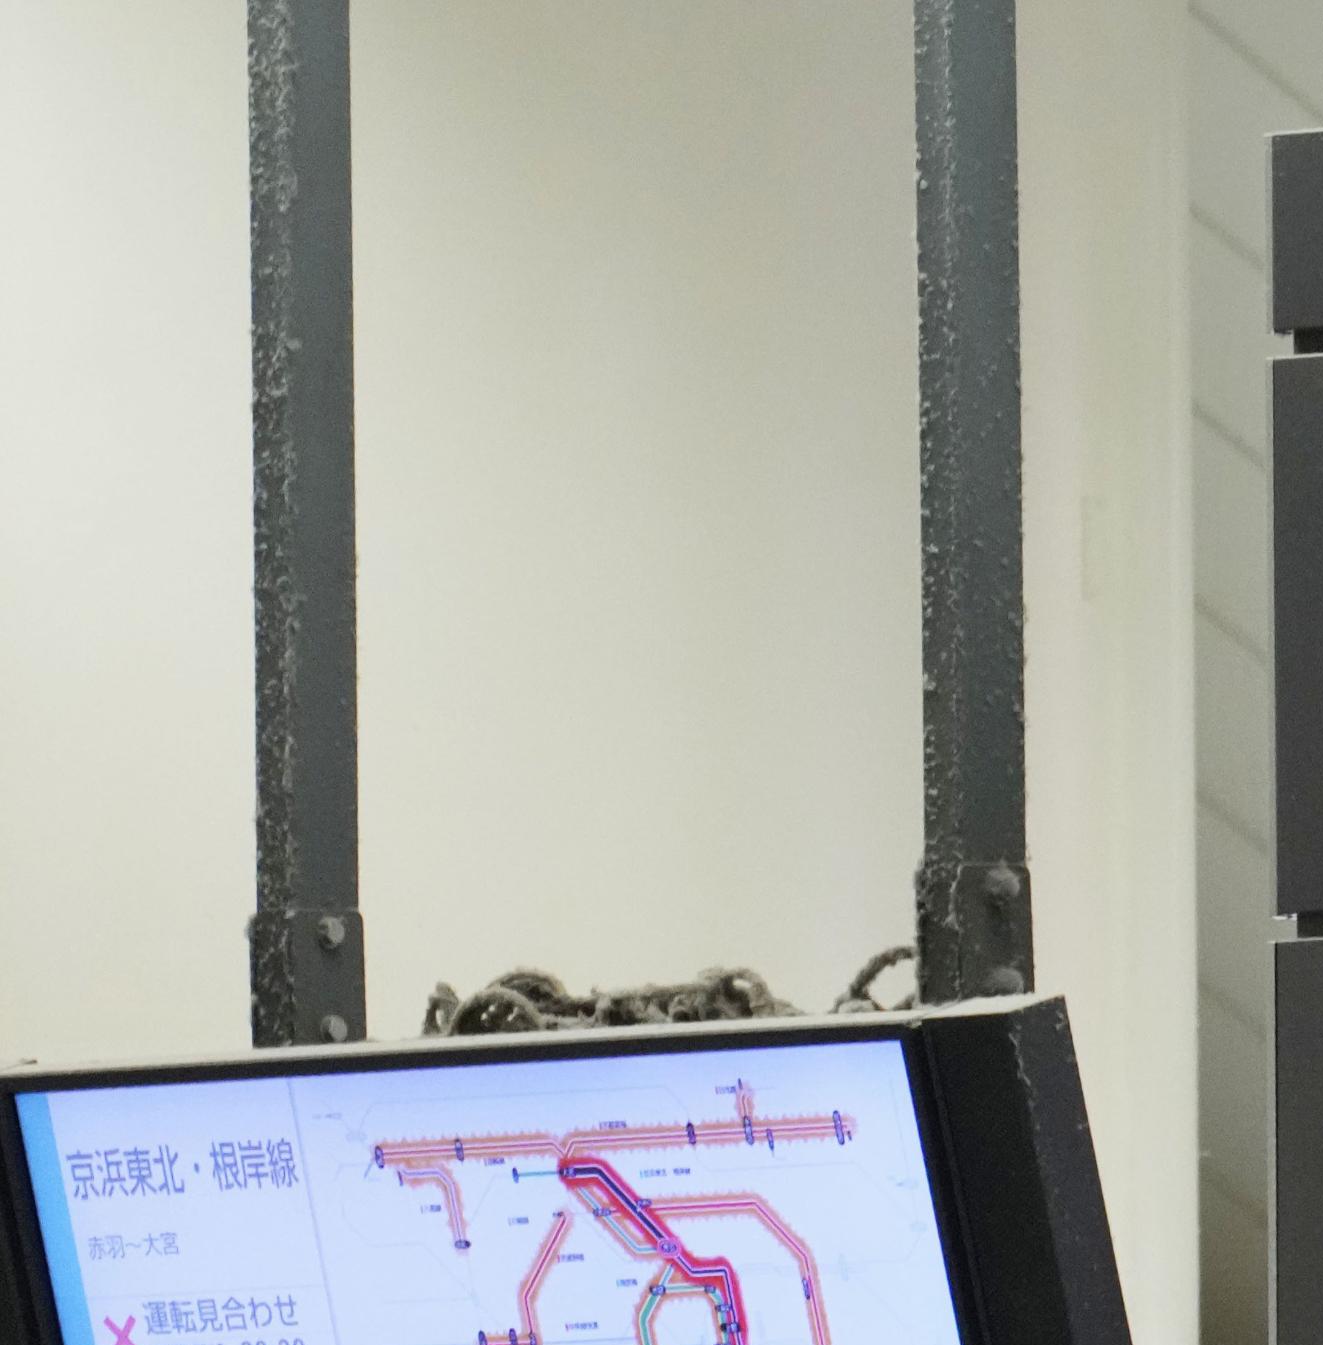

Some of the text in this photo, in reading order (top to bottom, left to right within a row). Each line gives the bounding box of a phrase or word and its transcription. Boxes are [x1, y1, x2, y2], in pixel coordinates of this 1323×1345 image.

[66, 1138, 299, 1201] 京浜東北・根岸線
[142, 1294, 299, 1336] 運転見合わせ
